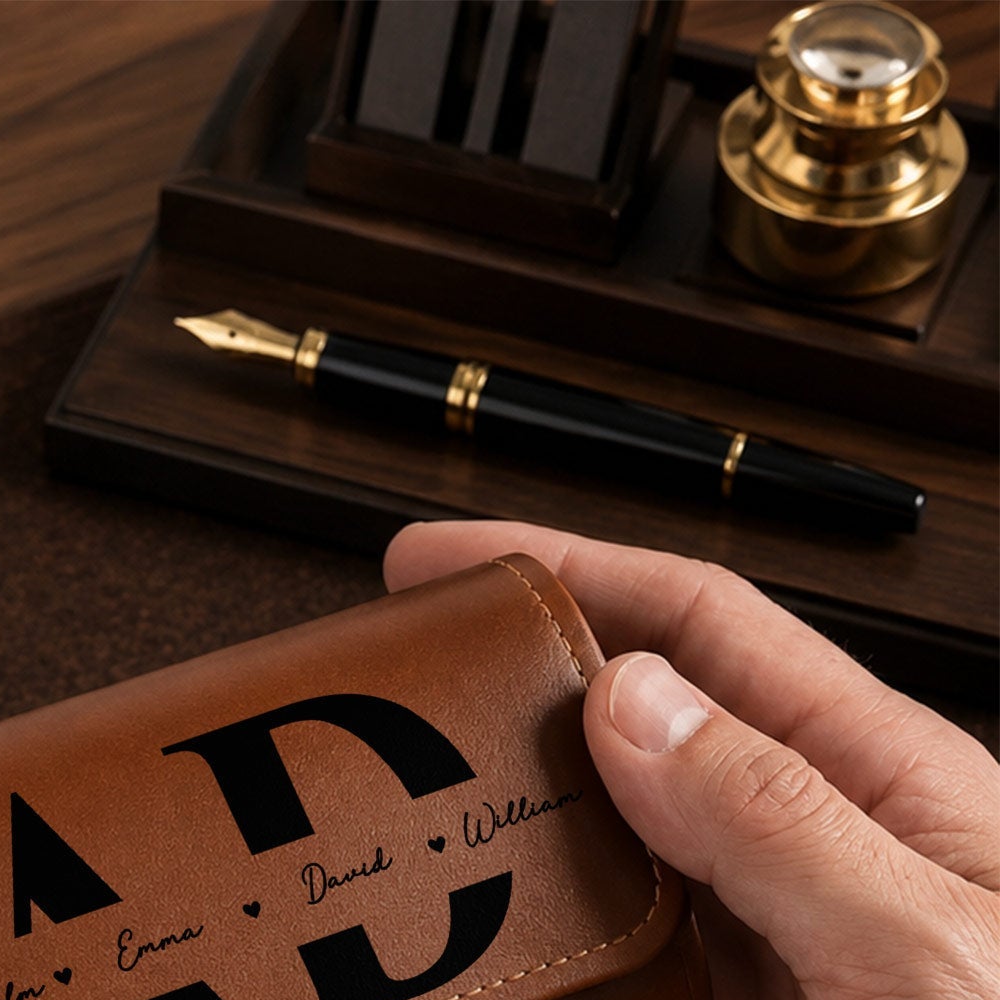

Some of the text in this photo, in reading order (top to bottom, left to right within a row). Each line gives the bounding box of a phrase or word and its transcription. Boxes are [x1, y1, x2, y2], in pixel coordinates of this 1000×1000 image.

[116, 925, 205, 971] Emma
[300, 847, 393, 905] David
[463, 789, 584, 848] William
